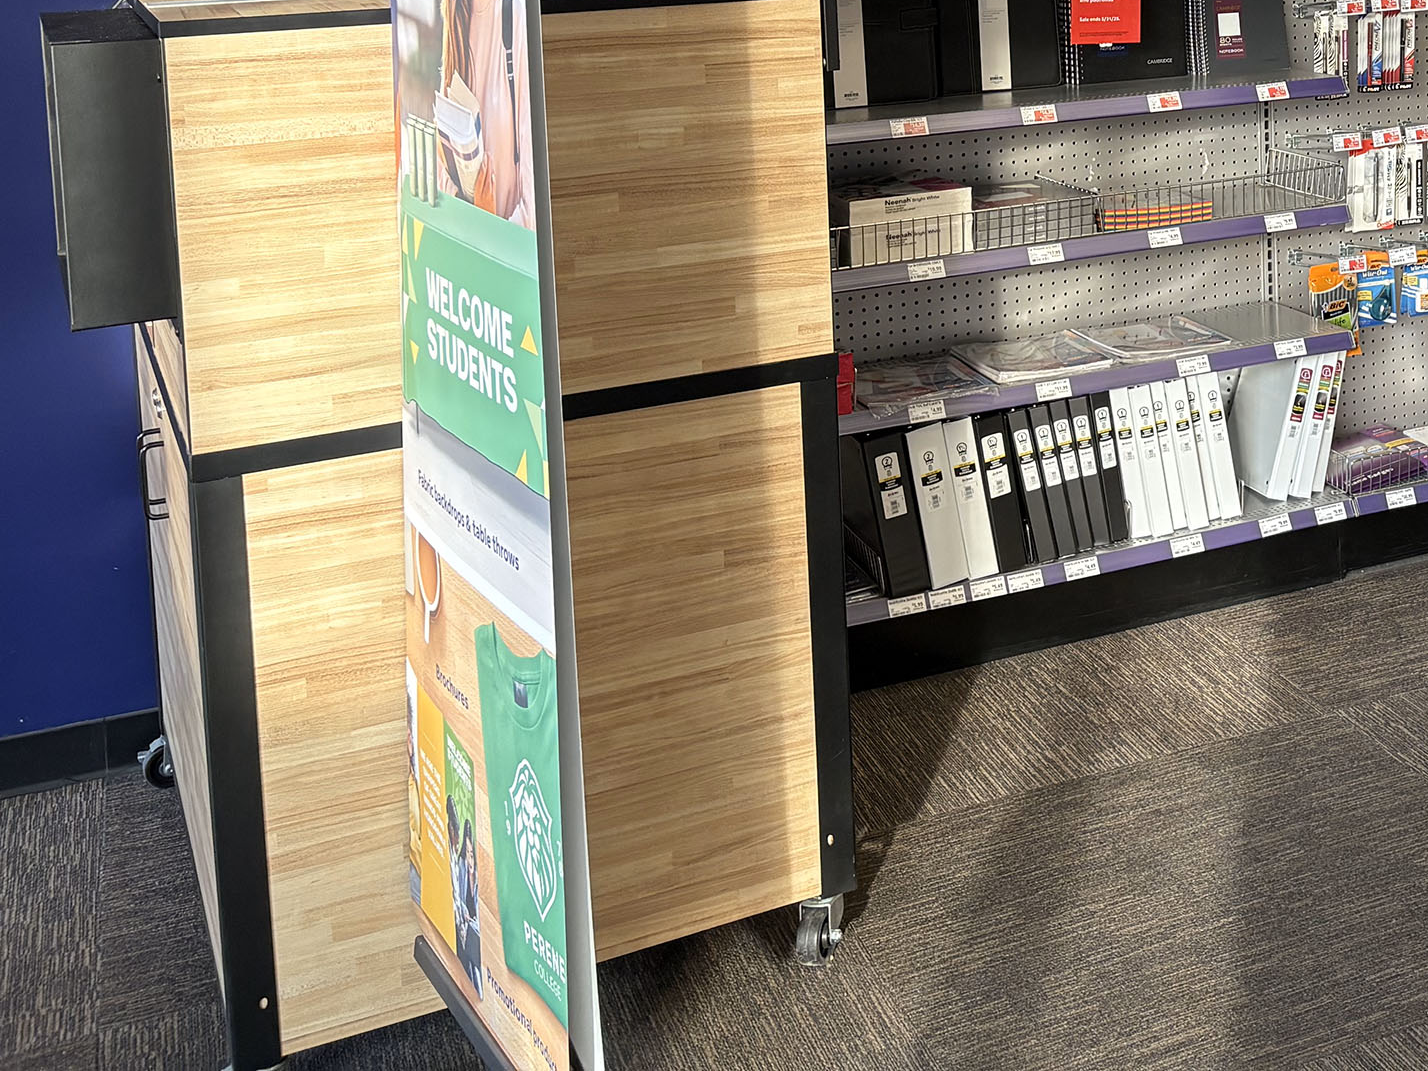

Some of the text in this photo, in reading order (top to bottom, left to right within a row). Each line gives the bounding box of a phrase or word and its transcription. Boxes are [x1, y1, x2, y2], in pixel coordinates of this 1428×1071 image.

[884, 197, 912, 207] Neenah
[426, 267, 514, 358] WELCOME
[1329, 299, 1347, 310] BIC
[427, 317, 518, 413] STUDENTS
[418, 469, 520, 571] Fabric backdrops & table throws
[435, 663, 470, 710] Brochures
[486, 967, 533, 1036] Promotional
